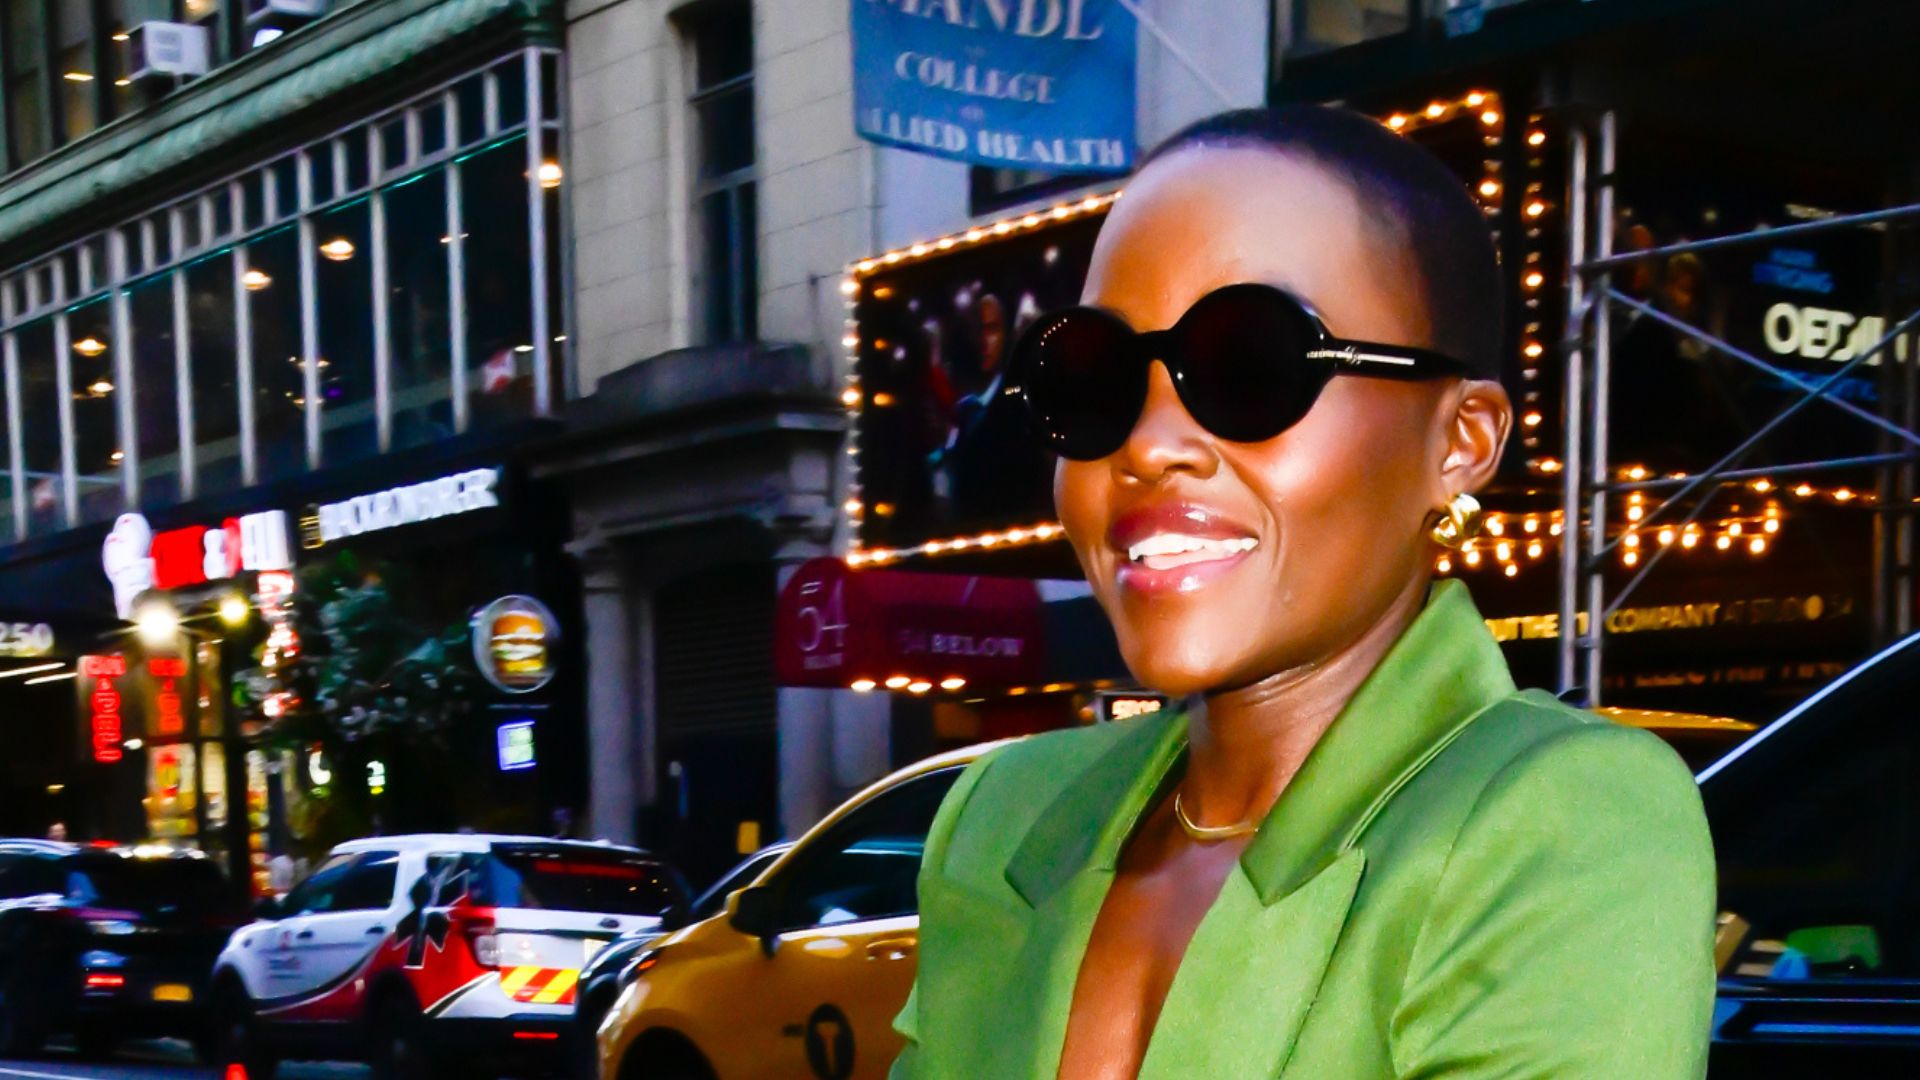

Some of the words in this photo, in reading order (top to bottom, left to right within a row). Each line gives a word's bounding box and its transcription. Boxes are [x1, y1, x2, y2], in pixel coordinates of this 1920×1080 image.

[866, 0, 1104, 40] ANDL
[895, 51, 1056, 103] COLLEGE
[868, 107, 968, 152] LLIED
[976, 129, 1126, 167] HEALTH
[1605, 603, 1720, 634] COMPANY
[930, 632, 1025, 657] BELOW
